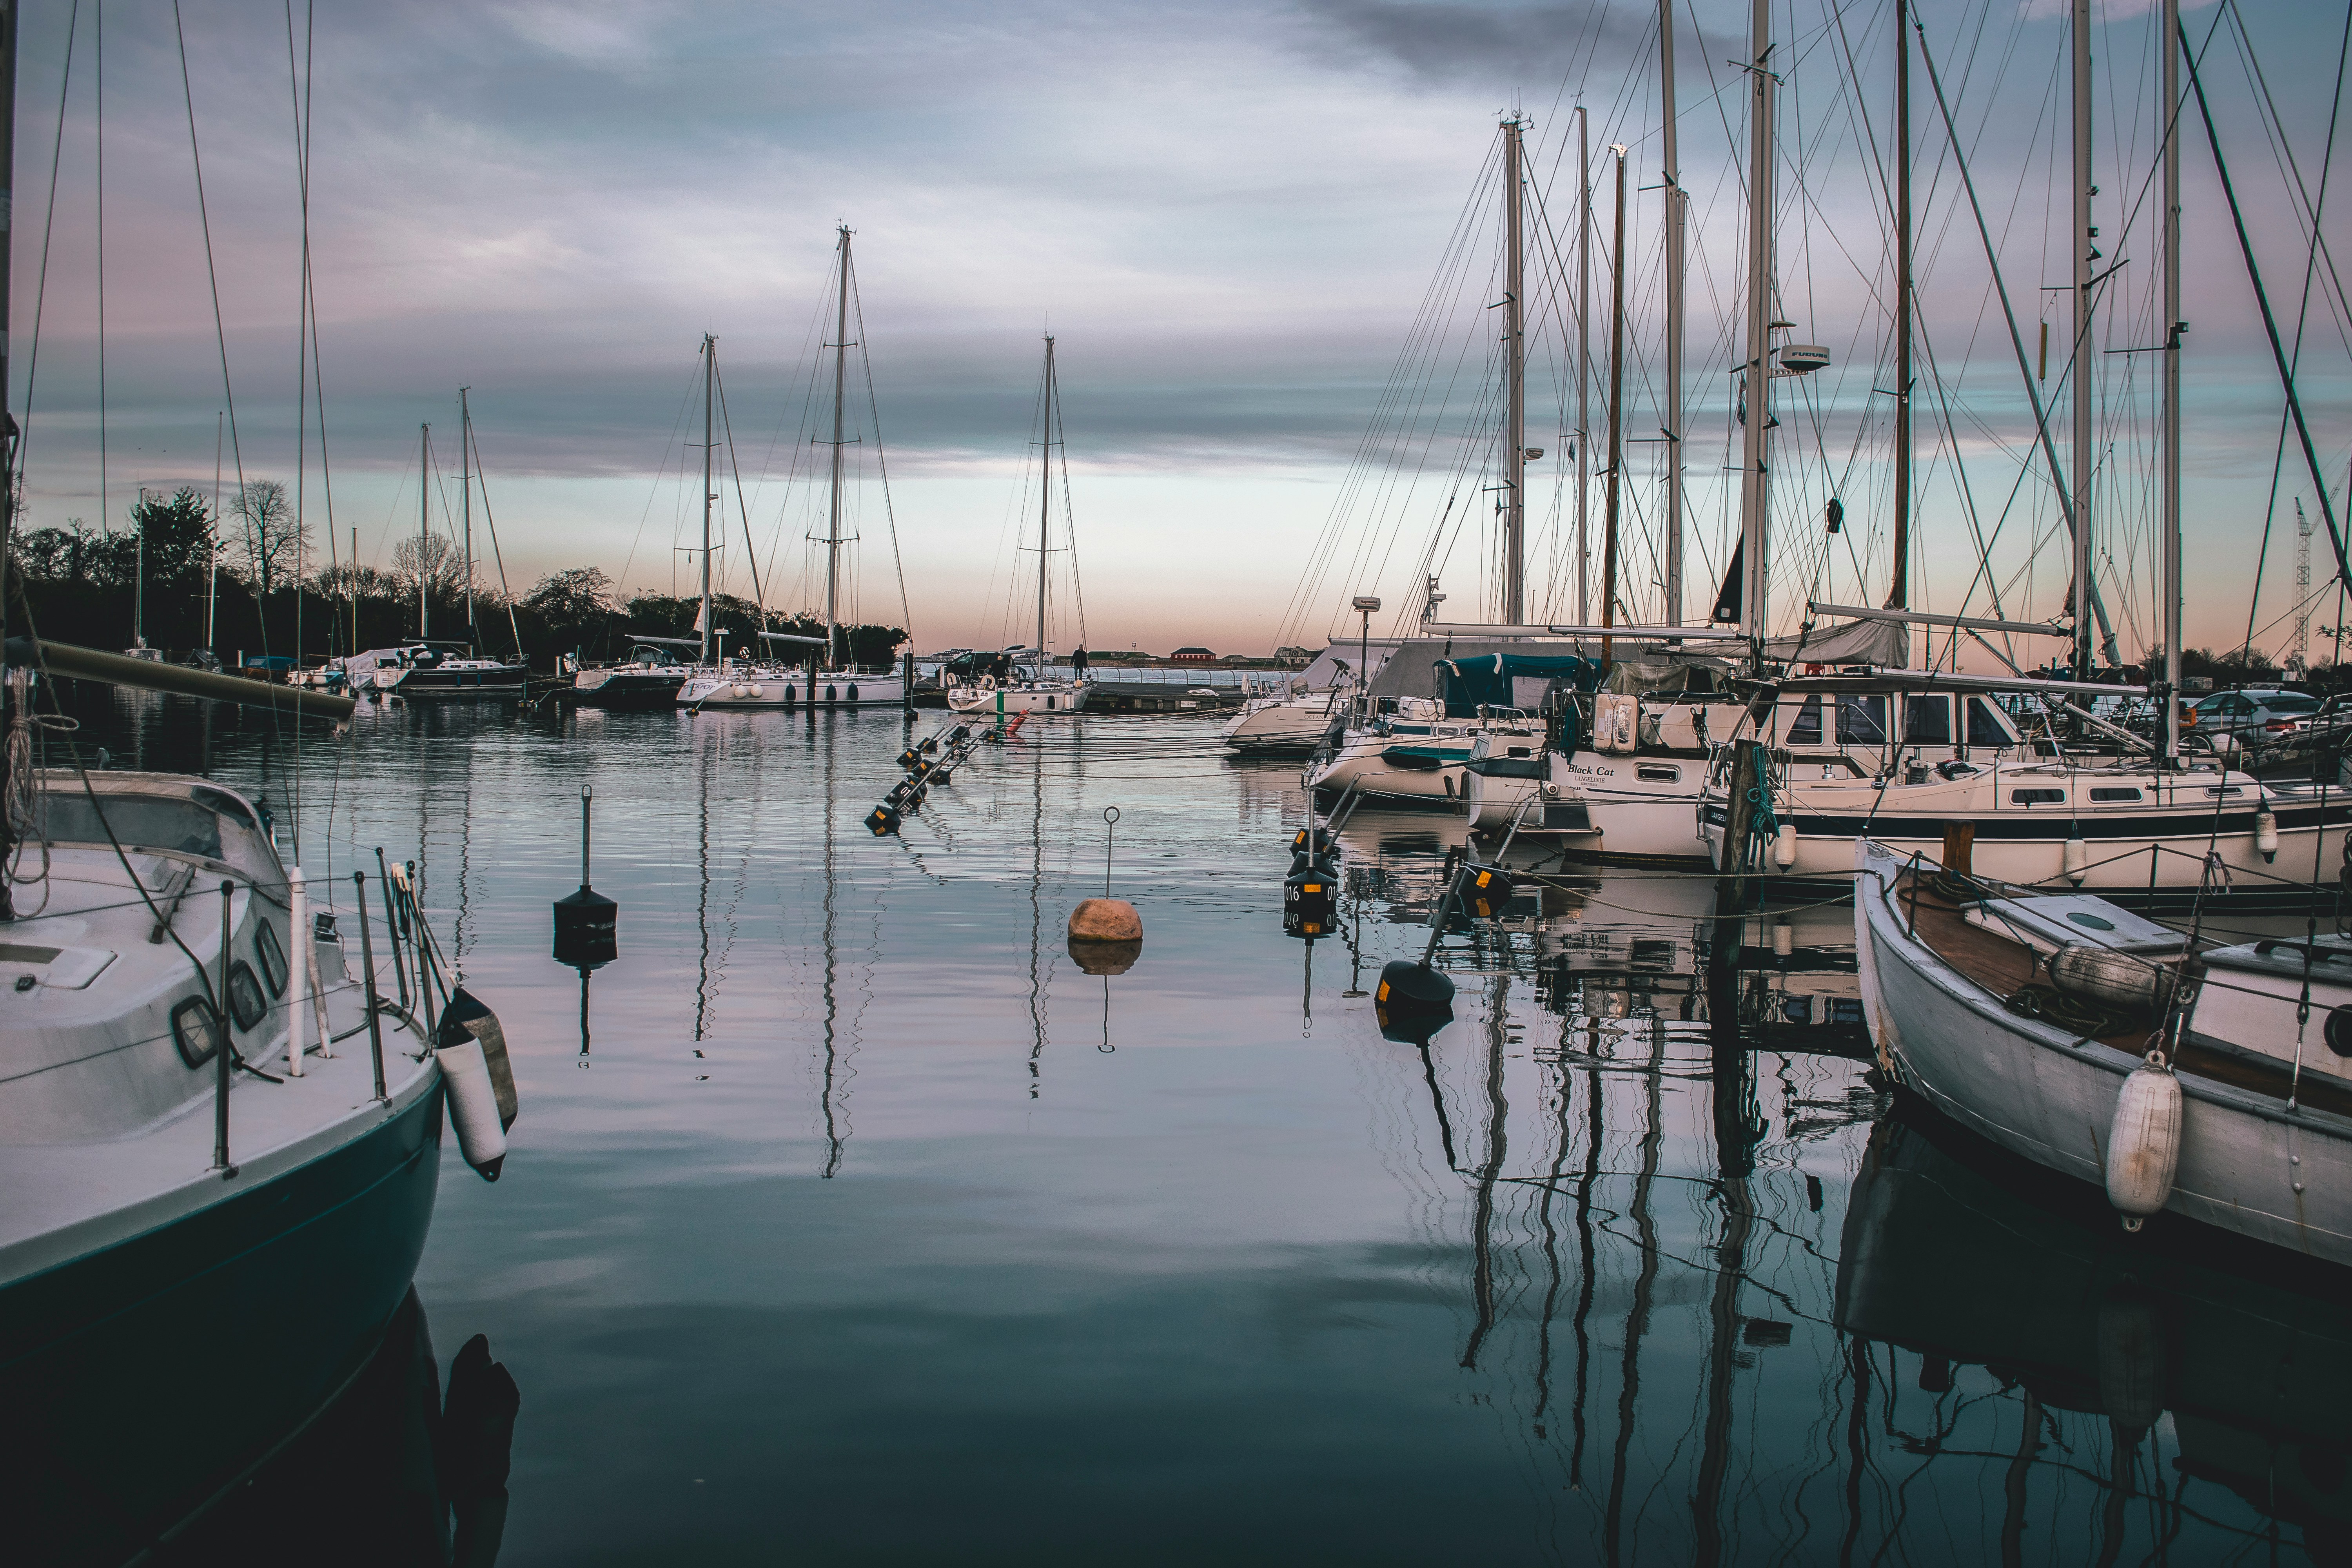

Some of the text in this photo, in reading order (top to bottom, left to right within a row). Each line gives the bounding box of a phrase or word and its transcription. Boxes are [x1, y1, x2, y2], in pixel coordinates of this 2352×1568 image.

[1568, 764, 1614, 776] Black Cat
[1285, 886, 1299, 901] 016
[1327, 886, 1337, 901] 01
